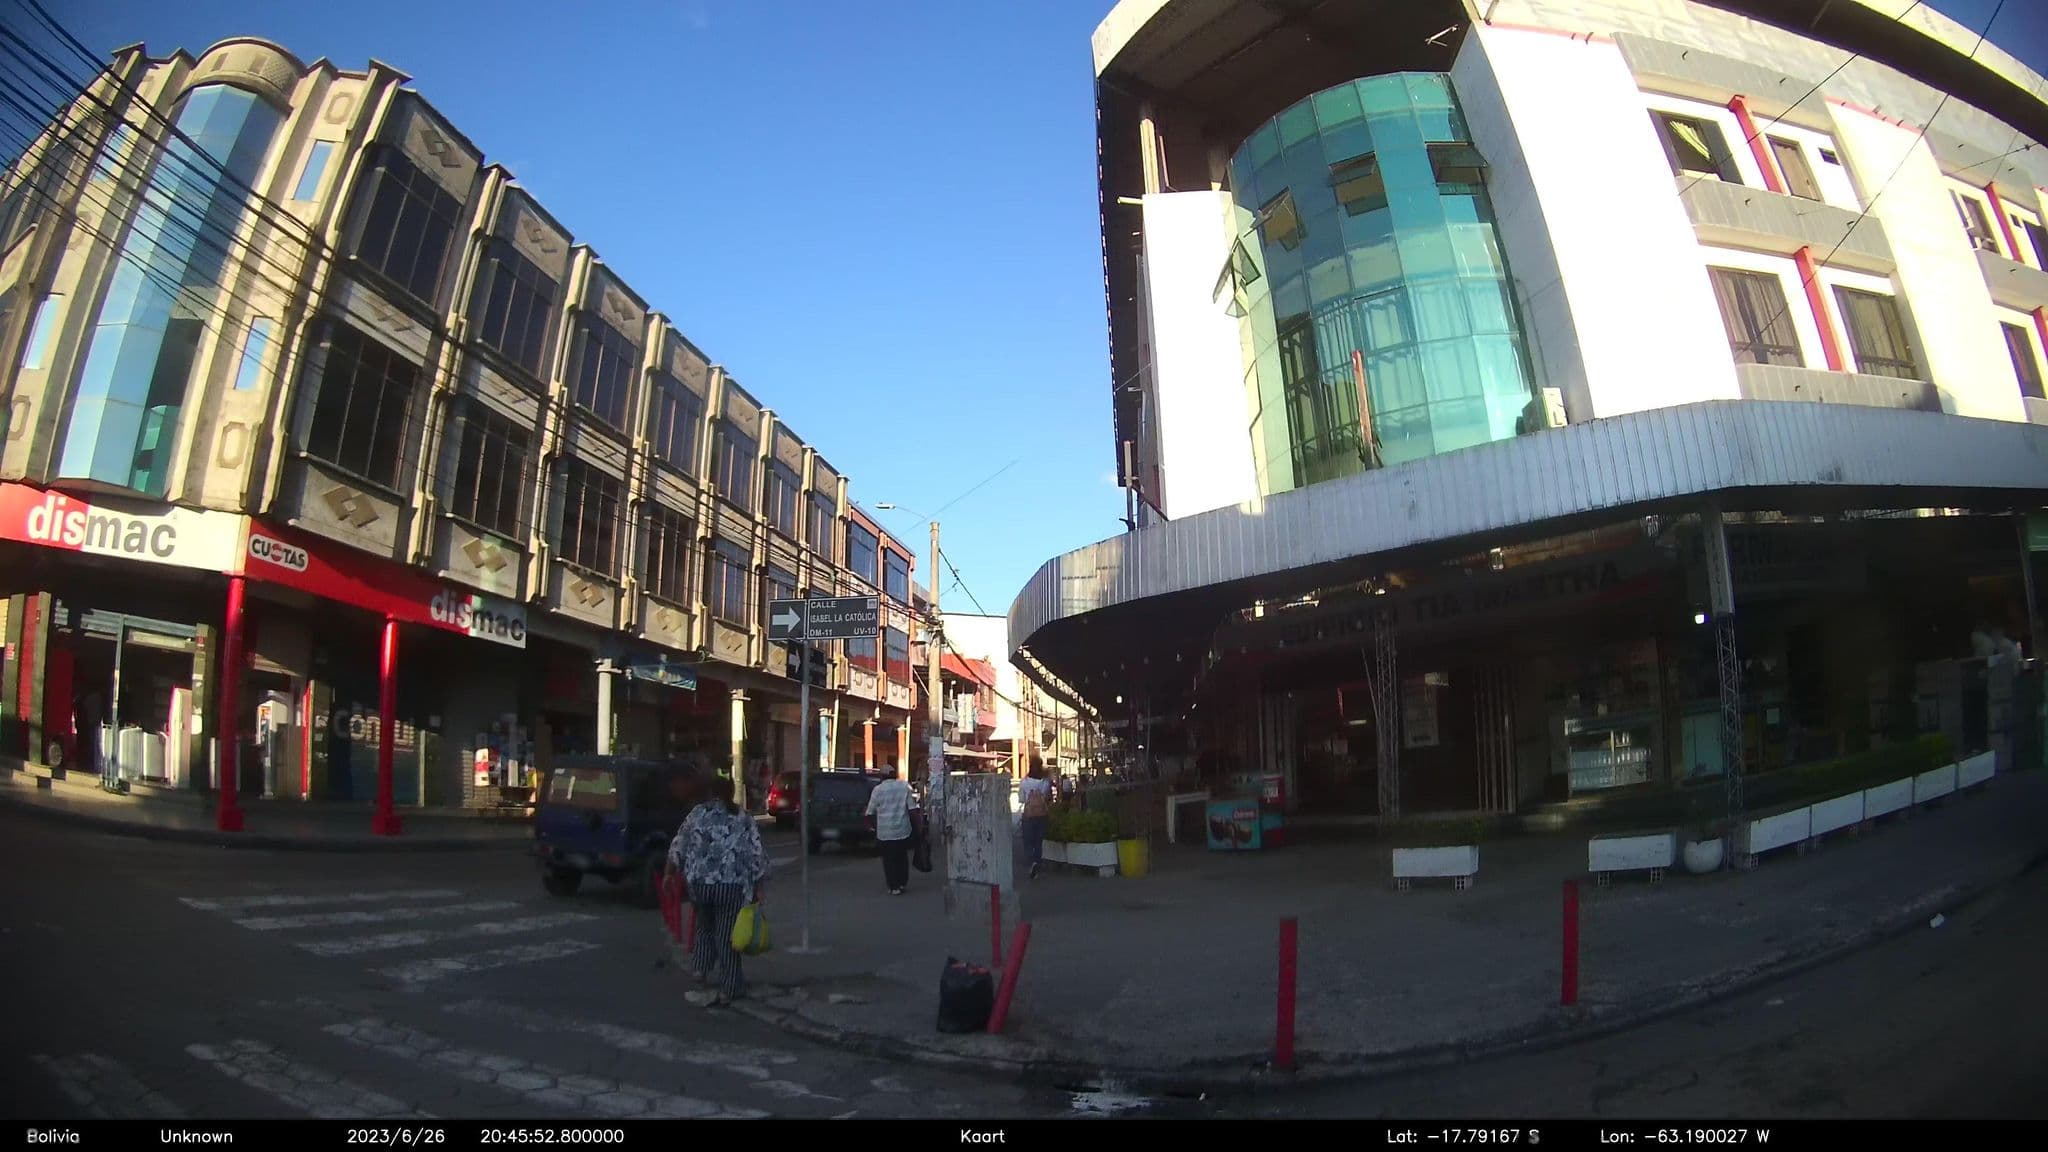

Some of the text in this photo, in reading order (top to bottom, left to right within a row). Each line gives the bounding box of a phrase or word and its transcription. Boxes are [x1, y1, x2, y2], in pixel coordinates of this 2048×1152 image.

[27, 495, 177, 558] dismac
[251, 538, 306, 569] CUOTAS
[430, 587, 525, 641] dismac
[810, 600, 837, 609] CALLE
[810, 614, 833, 623] ISABEL
[834, 614, 843, 622] LA
[809, 627, 876, 637] DM-11 UV-10
